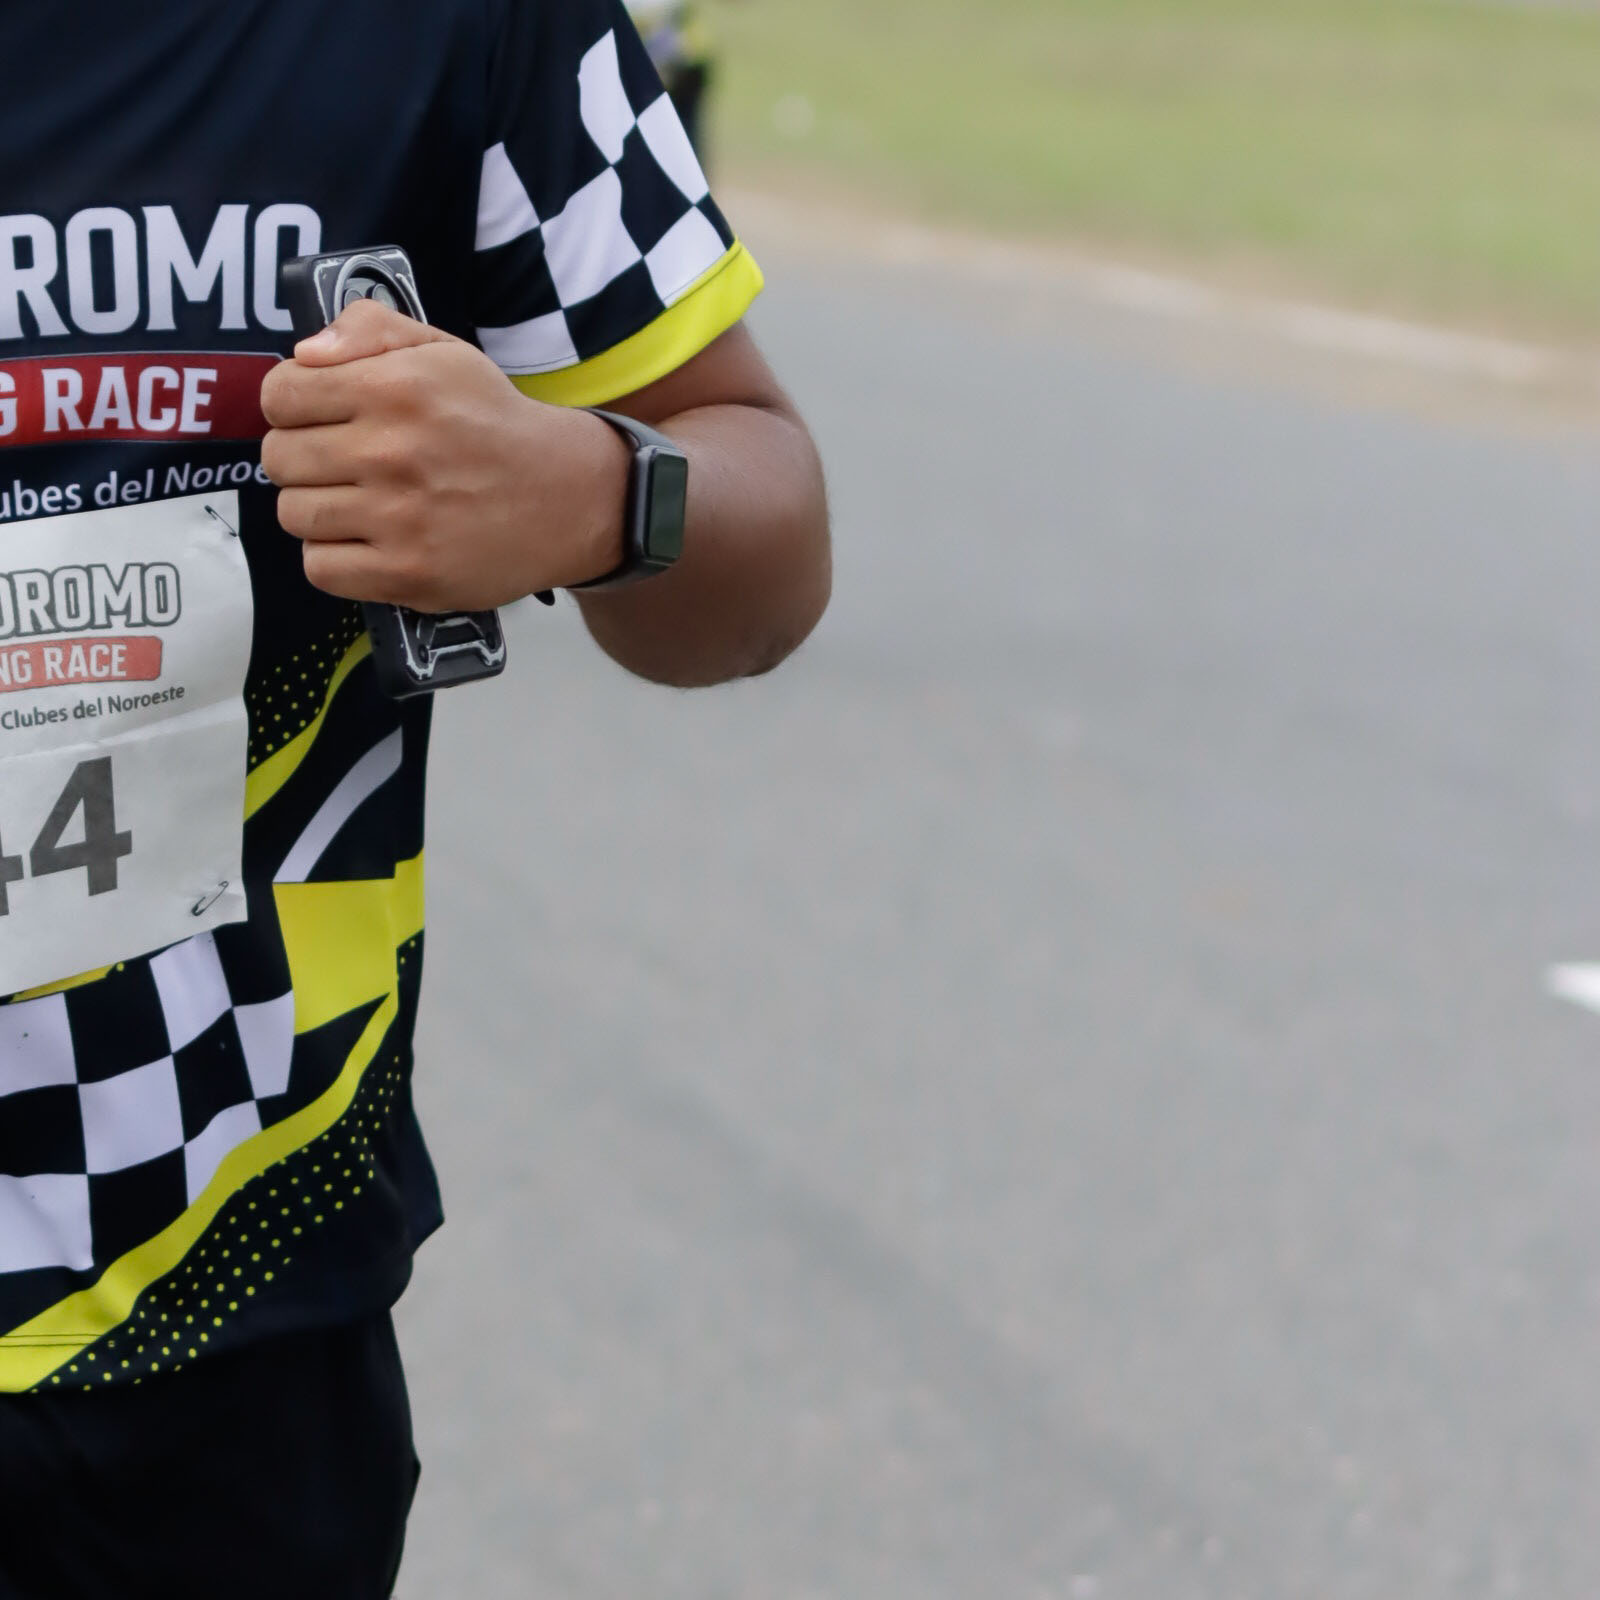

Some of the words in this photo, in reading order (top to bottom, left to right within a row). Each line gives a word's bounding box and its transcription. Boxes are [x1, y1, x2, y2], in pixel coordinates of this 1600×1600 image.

[42, 366, 218, 434] RACE
[95, 471, 154, 507] del
[163, 461, 273, 494] Noroe
[43, 644, 127, 681] RACE
[0, 704, 69, 730] Clubes
[73, 697, 103, 719] del
[108, 685, 185, 714] Noroeste
